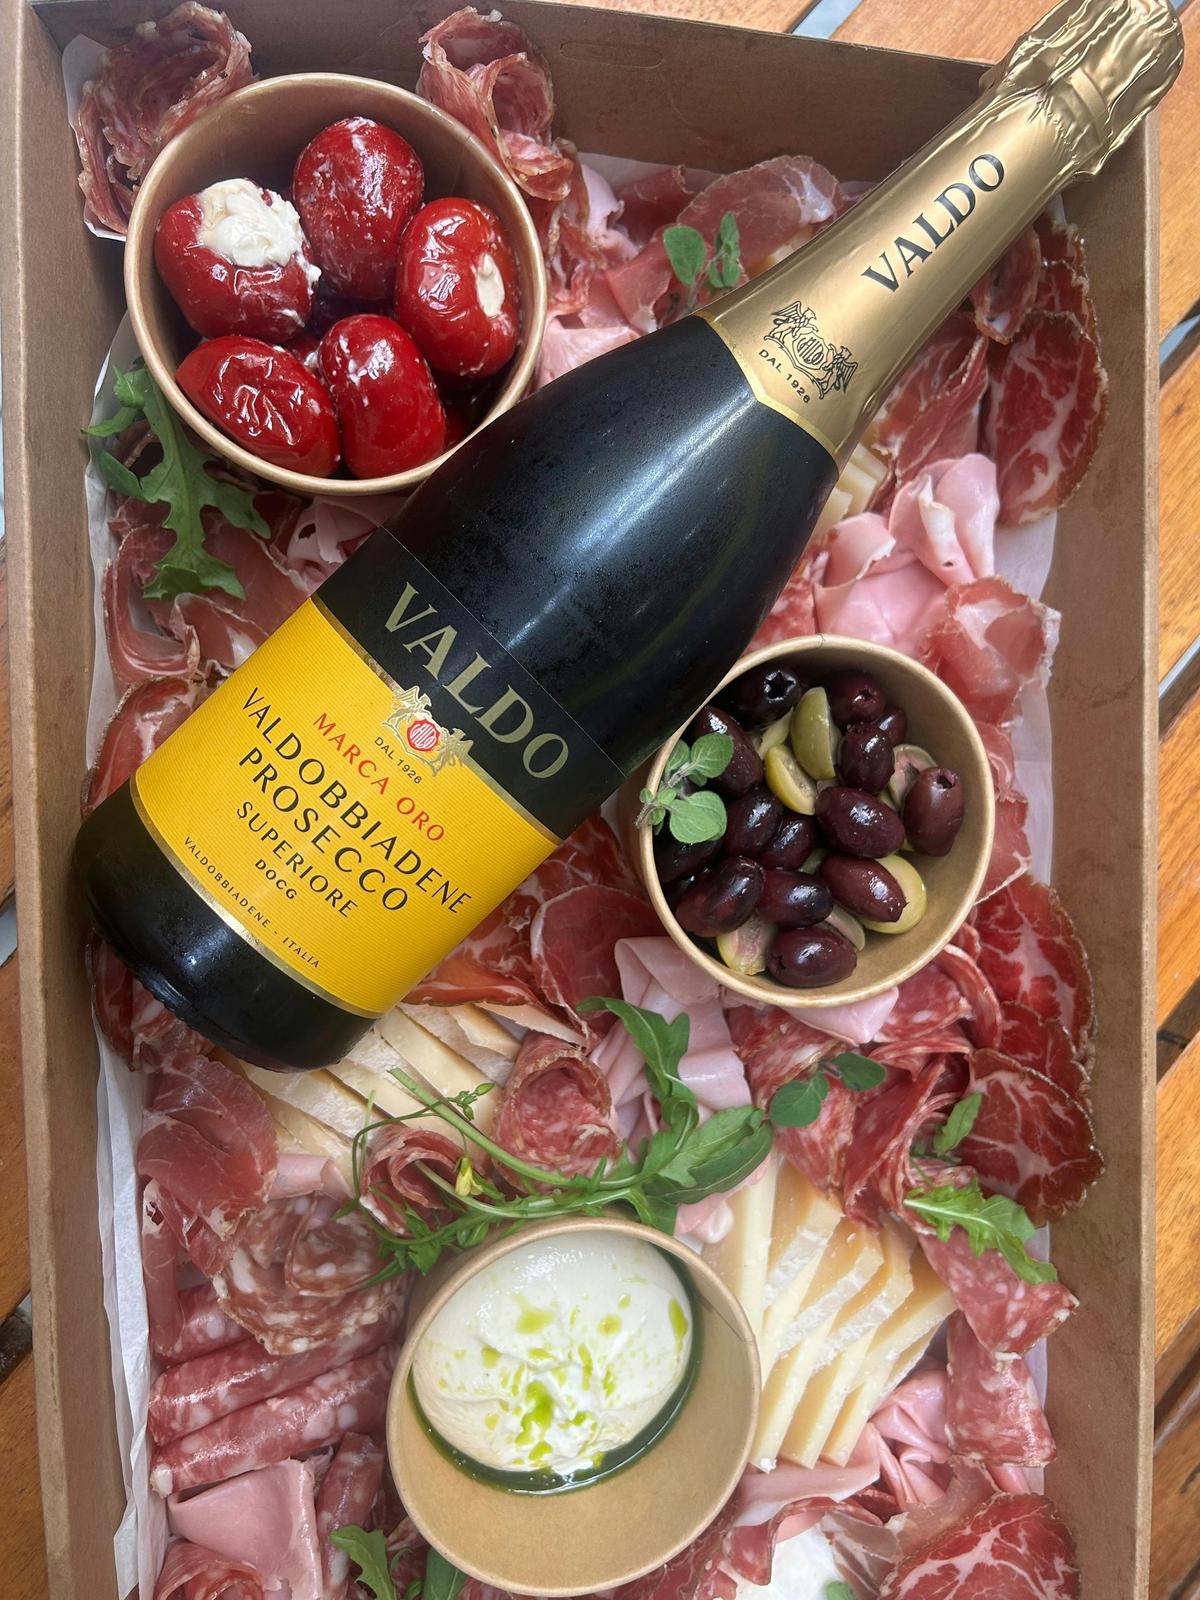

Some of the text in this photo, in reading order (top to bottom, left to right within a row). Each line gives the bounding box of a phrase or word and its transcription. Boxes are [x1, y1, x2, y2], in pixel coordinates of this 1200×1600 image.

[861, 154, 1005, 293] VALDO
[758, 349, 782, 373] DAL
[786, 373, 811, 403] 1926
[384, 581, 570, 779] VALDO
[242, 687, 472, 914] VALDOBBIADENE
[313, 713, 389, 795] MARCA
[396, 796, 445, 842] ORO
[374, 736, 397, 760] DAL
[396, 759, 423, 784] 1926
[236, 801, 359, 918] SUPERIORE
[239, 747, 408, 911] PROSECCO
[255, 859, 297, 900] DOCG
[184, 836, 271, 928] VALDOBBIADENE
[282, 936, 320, 968] ITALIA
